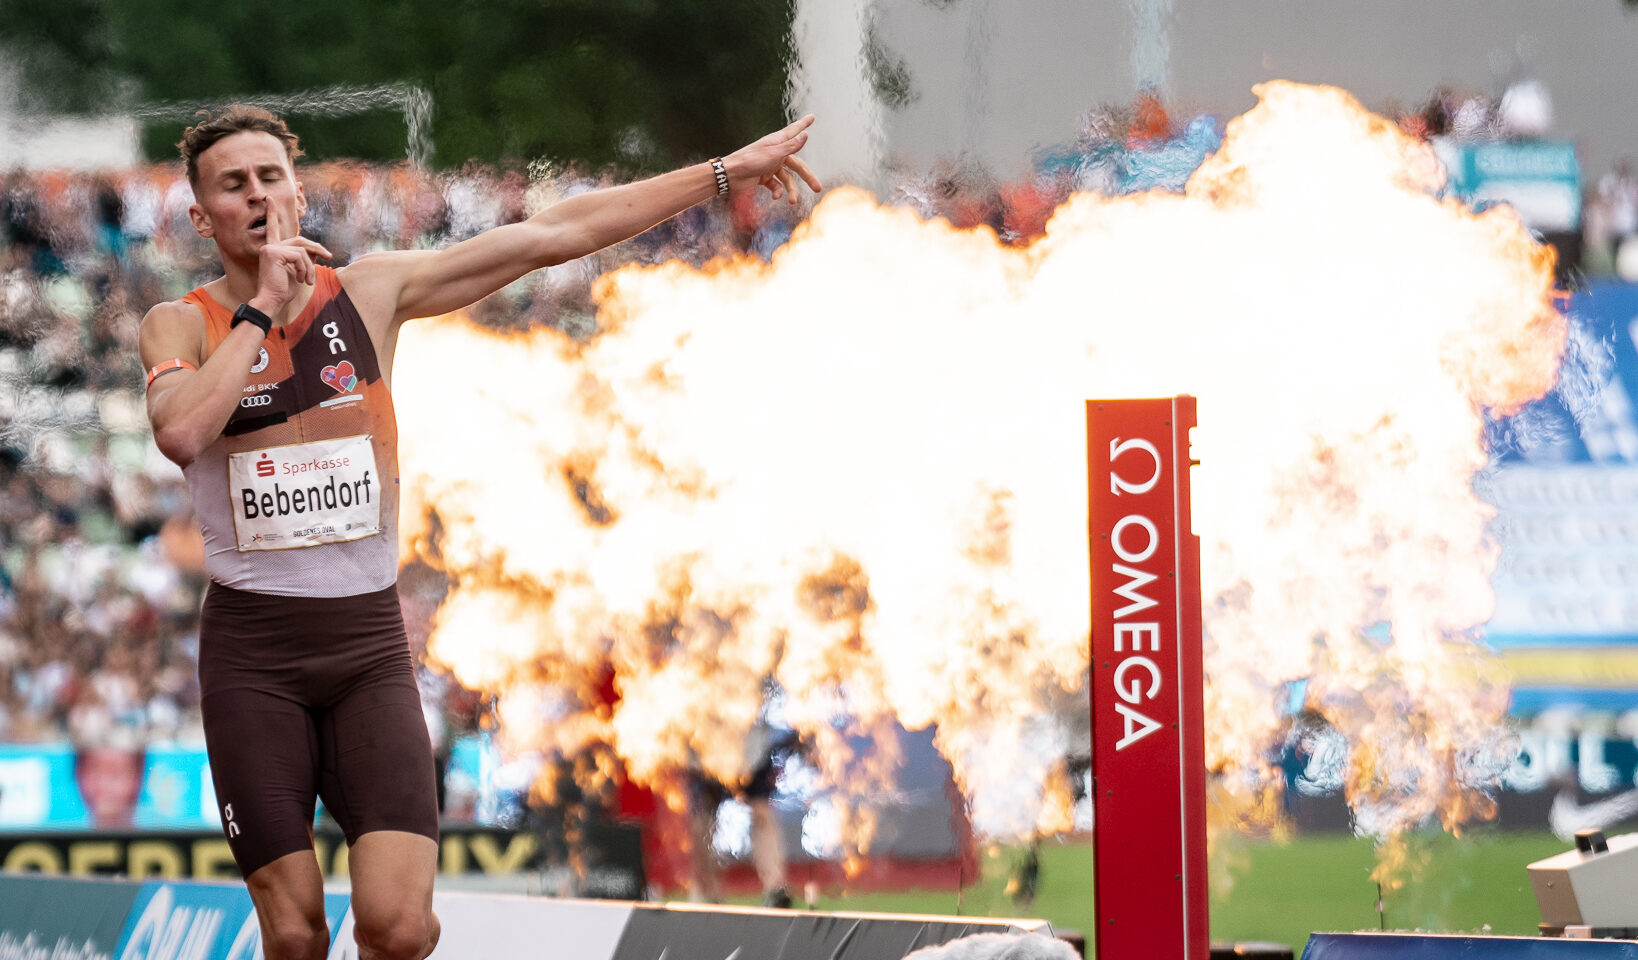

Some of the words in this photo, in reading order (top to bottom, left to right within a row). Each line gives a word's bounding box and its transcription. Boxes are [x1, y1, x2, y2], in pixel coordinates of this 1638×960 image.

[282, 457, 350, 476] Sparkasse
[241, 470, 371, 520] Bebendorf
[1110, 514, 1163, 751] OMEGA
